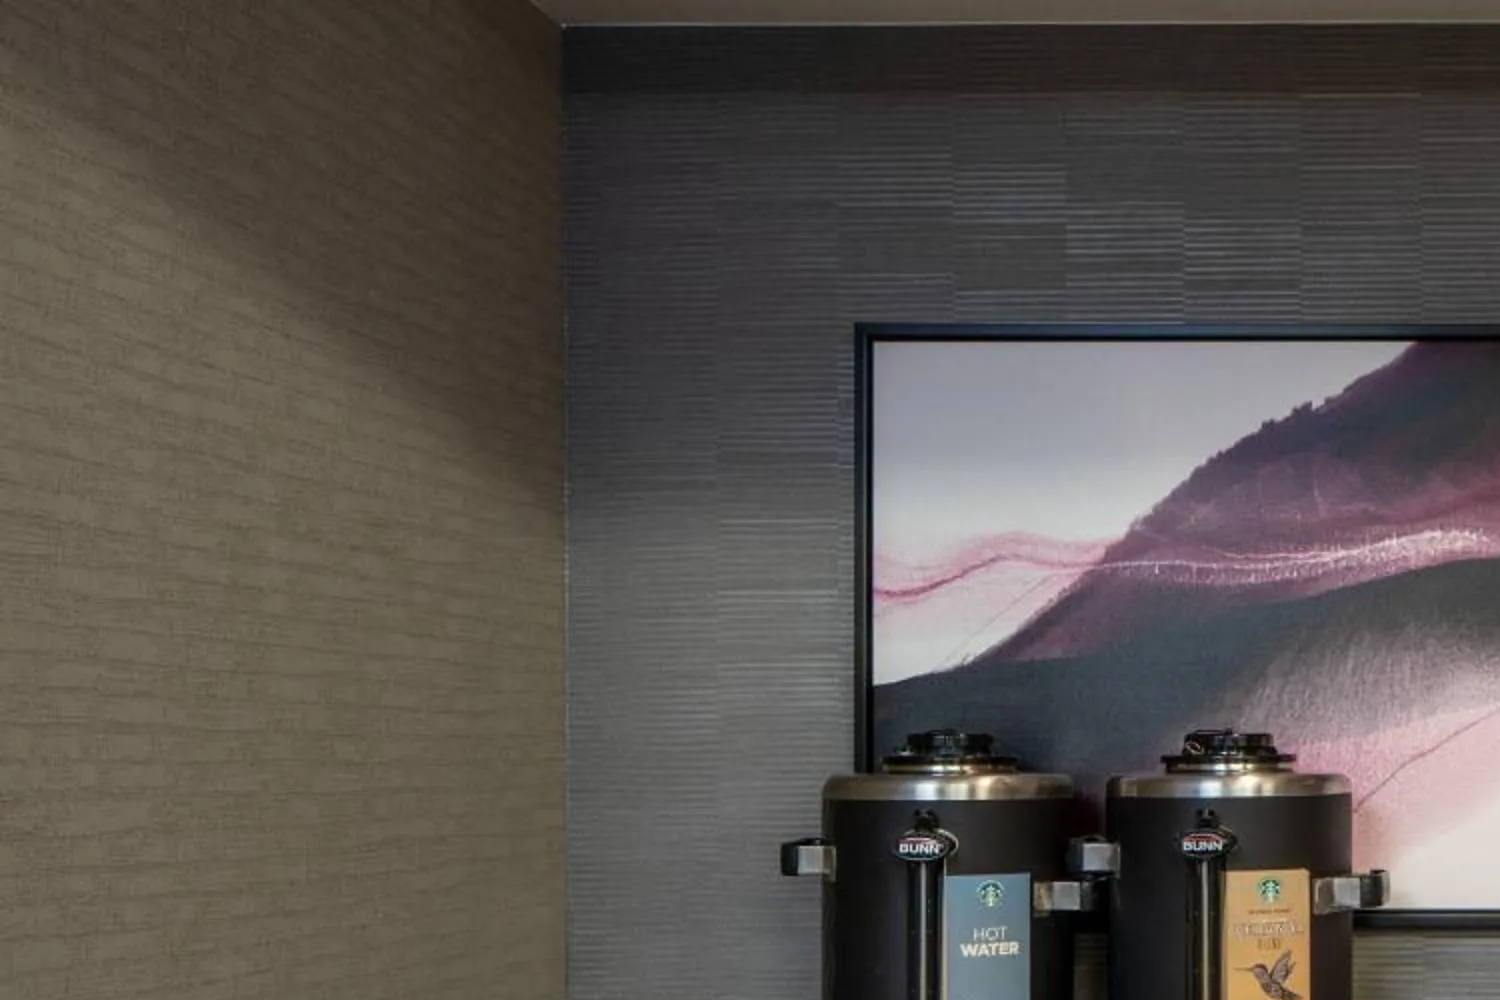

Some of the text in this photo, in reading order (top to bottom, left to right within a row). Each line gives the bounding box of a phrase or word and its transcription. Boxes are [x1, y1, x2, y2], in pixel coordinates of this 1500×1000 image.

[899, 842, 940, 855] BUNN
[1183, 840, 1223, 852] BUNN
[973, 927, 1008, 941] HOT
[960, 940, 1020, 957] WATER
